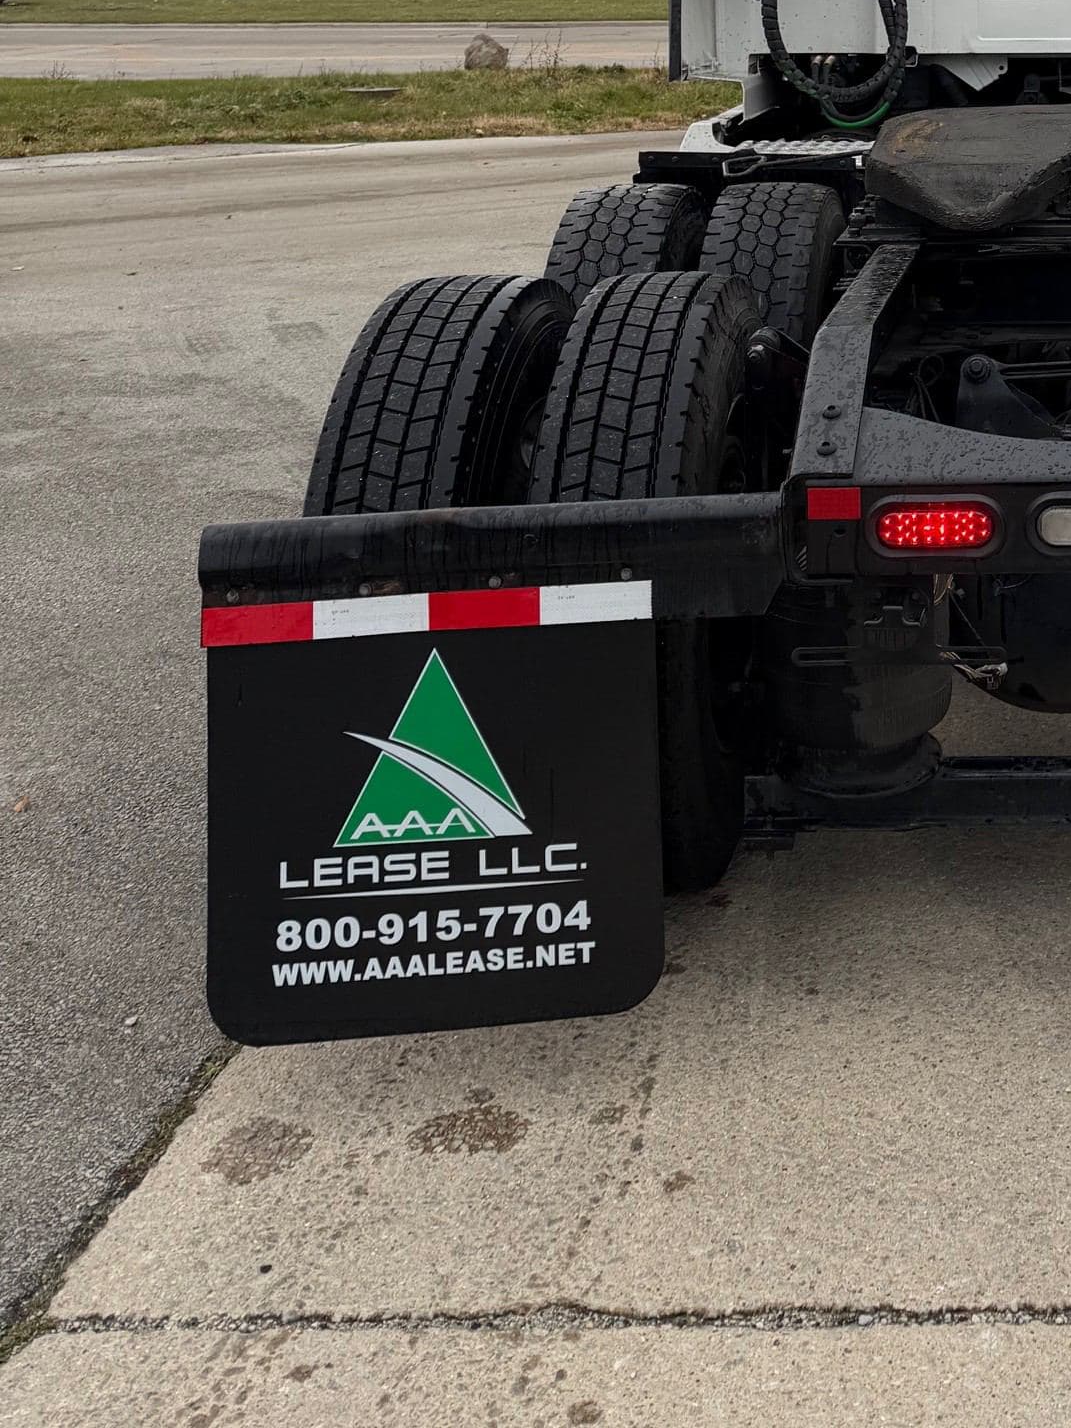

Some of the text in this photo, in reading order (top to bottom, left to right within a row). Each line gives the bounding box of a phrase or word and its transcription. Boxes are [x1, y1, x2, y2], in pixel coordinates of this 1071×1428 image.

[350, 808, 477, 840] AAA
[279, 842, 588, 889] LEASE LLC.
[276, 899, 592, 952] 800-915-7704
[271, 941, 597, 987] WWW.AAALEASE.NET
